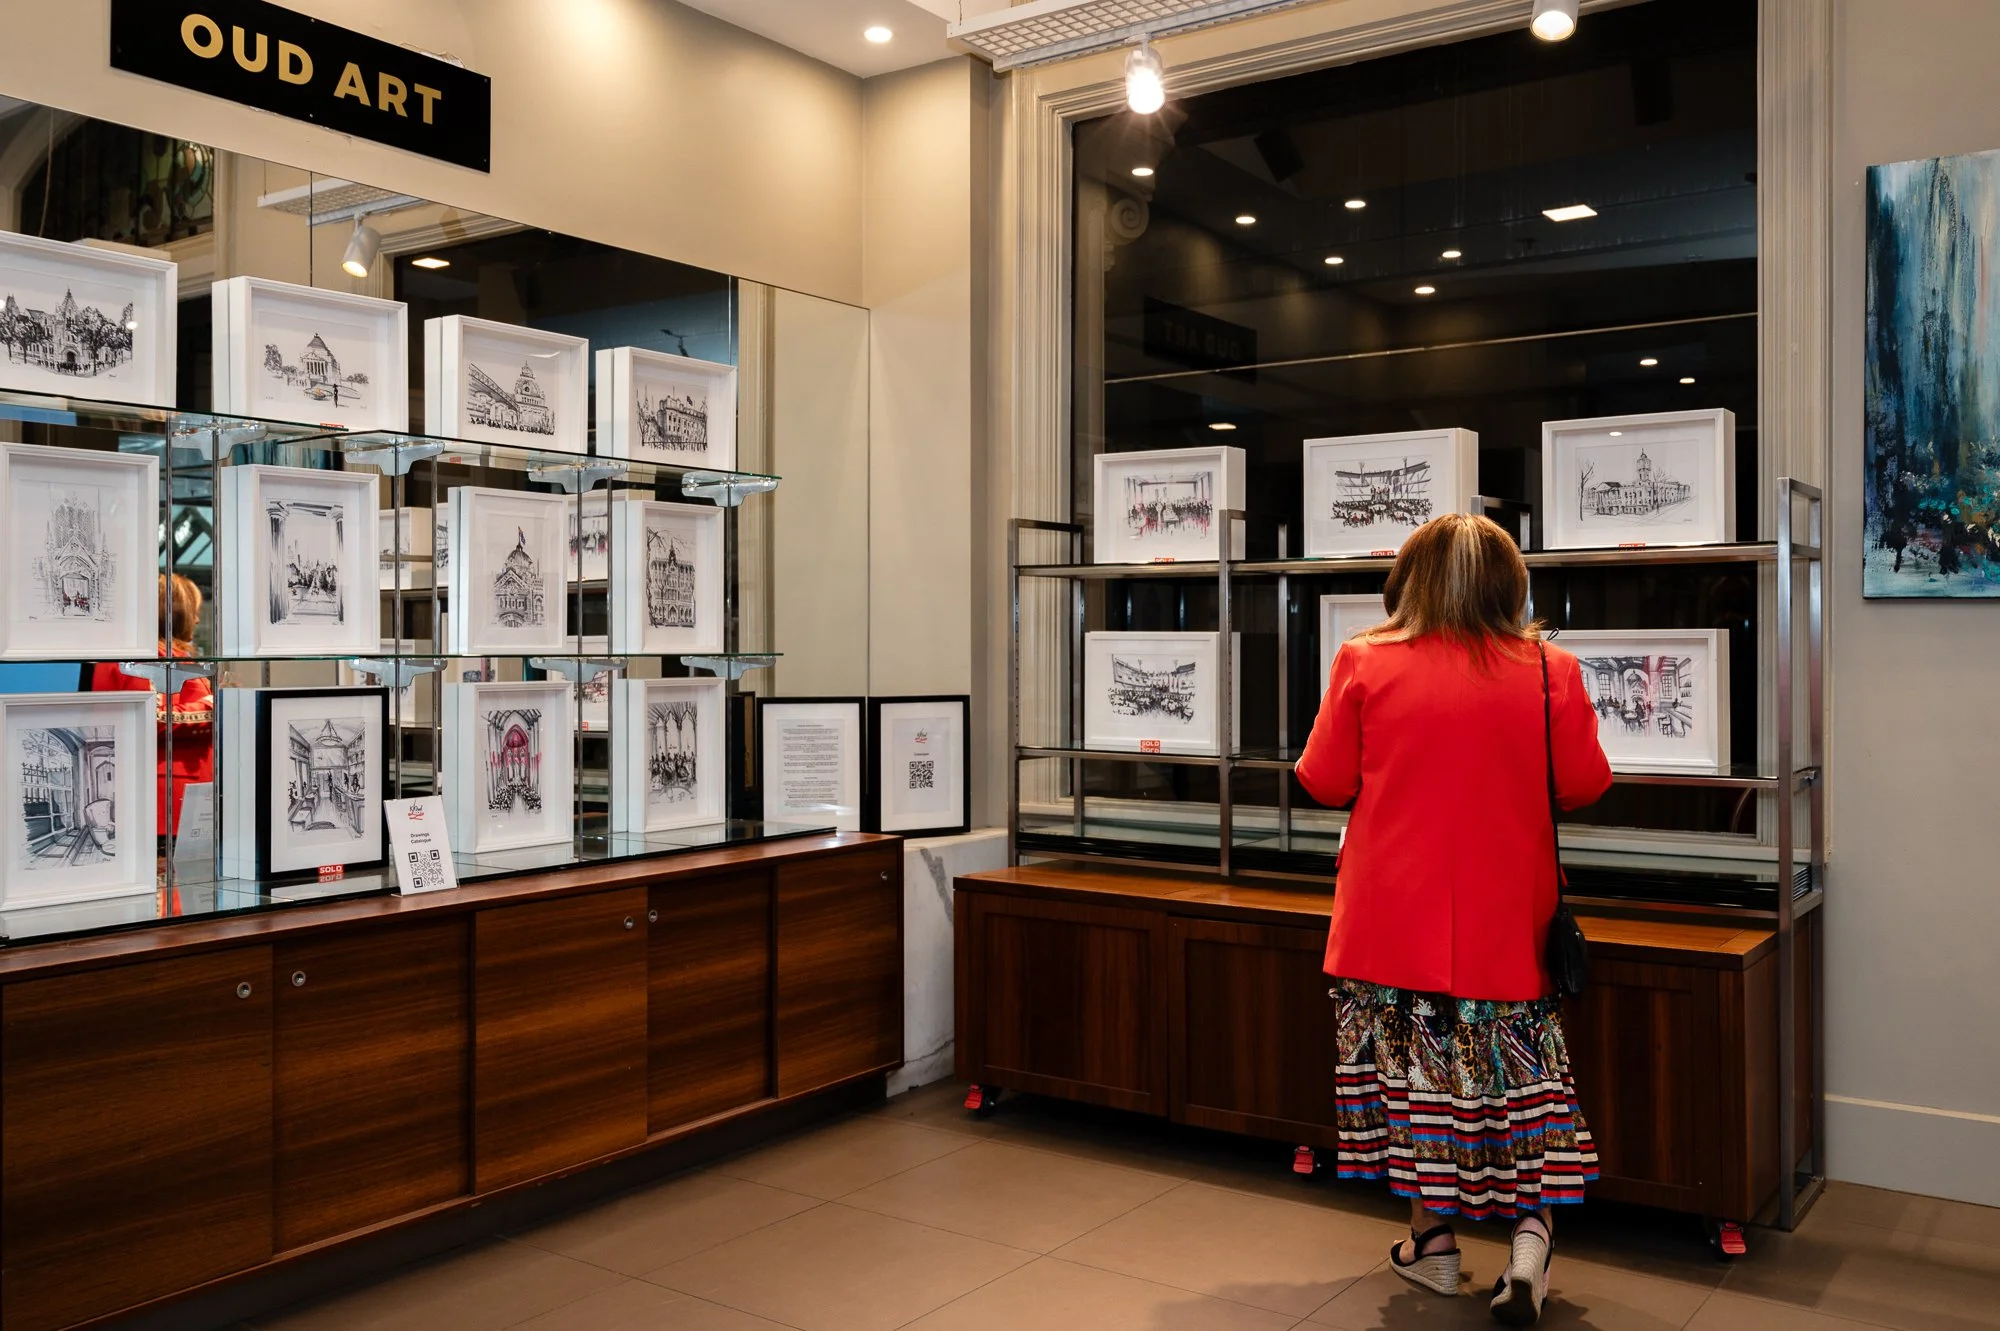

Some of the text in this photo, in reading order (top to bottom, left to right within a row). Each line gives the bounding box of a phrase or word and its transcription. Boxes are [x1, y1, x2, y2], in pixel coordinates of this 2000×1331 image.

[181, 13, 442, 125] OUD ART
[320, 865, 342, 873] SOLD
